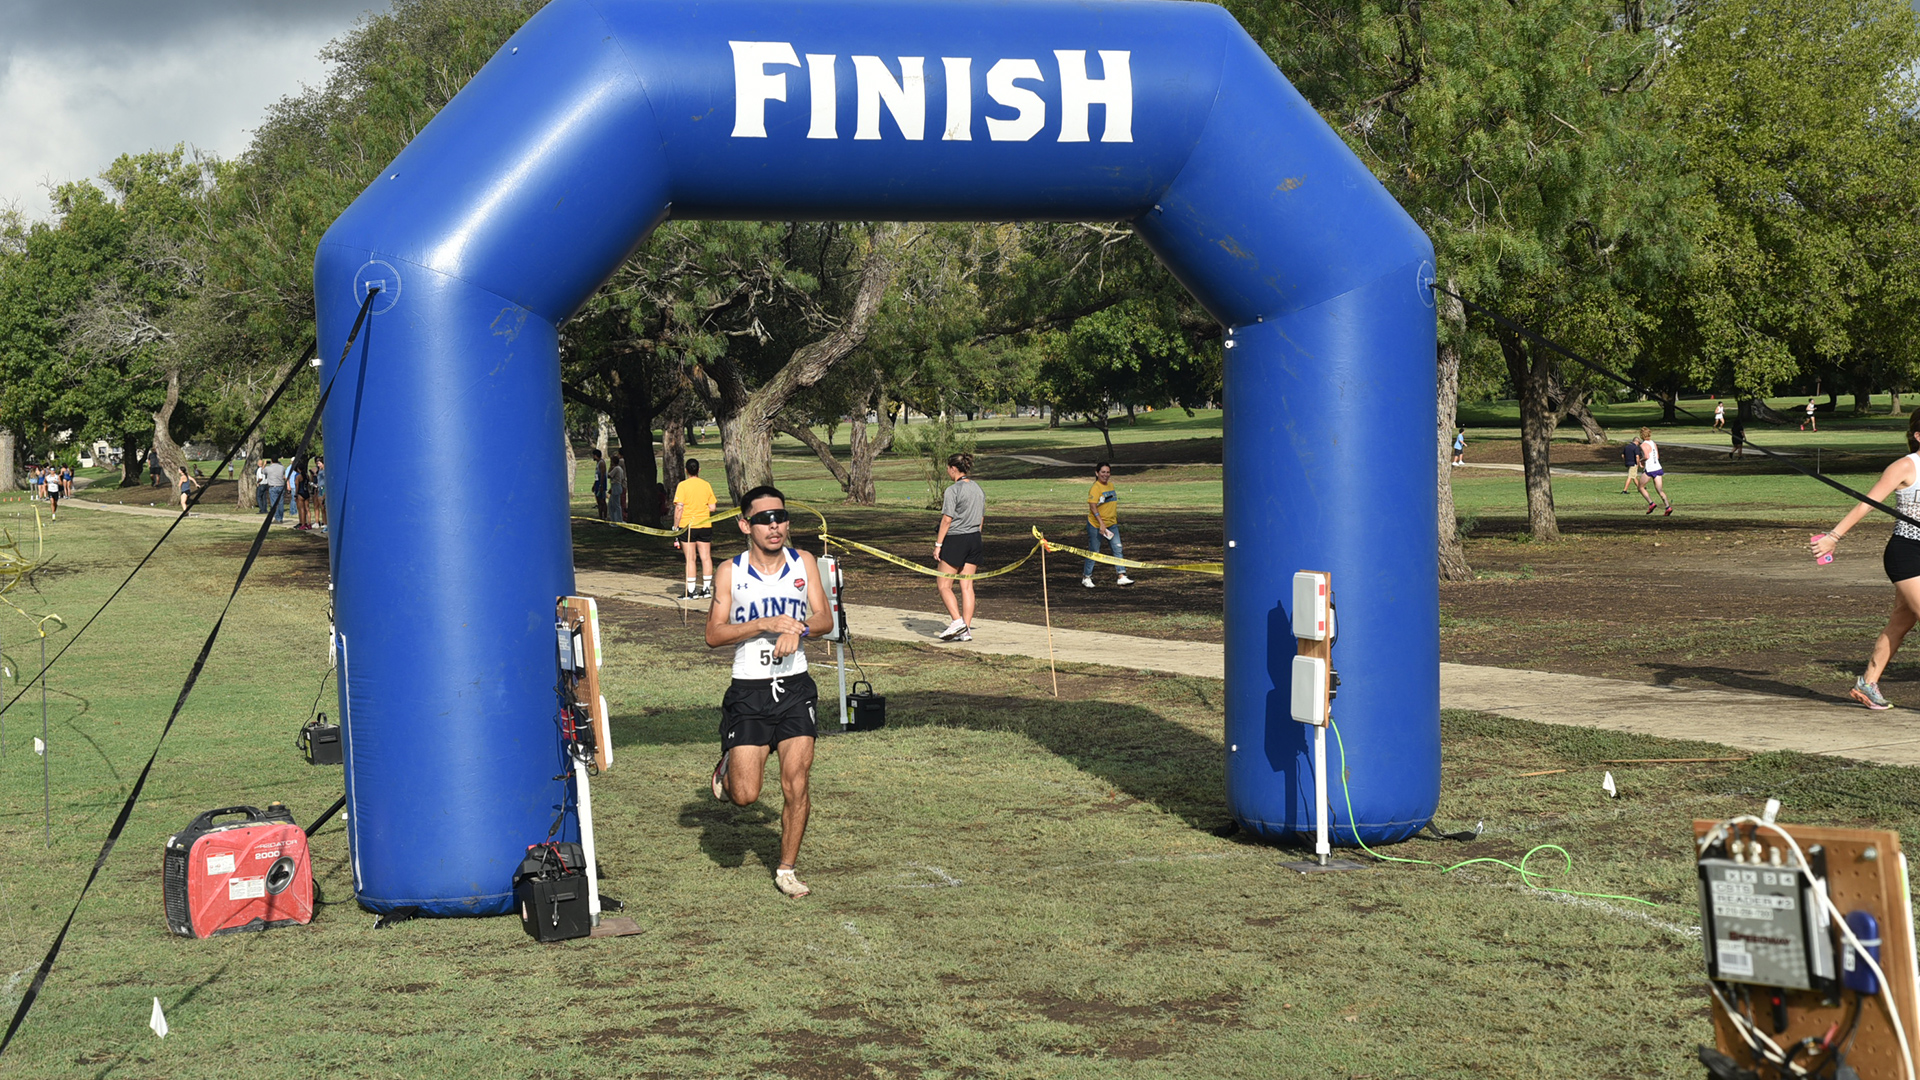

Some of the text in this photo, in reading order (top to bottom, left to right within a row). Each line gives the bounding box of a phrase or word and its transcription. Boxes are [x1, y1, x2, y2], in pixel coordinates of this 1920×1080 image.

[728, 40, 1134, 142] FINISH
[735, 597, 807, 623] SAINTS
[254, 840, 298, 849] PREDATOR
[255, 851, 281, 860] 2000
[1718, 895, 1772, 906] READER
